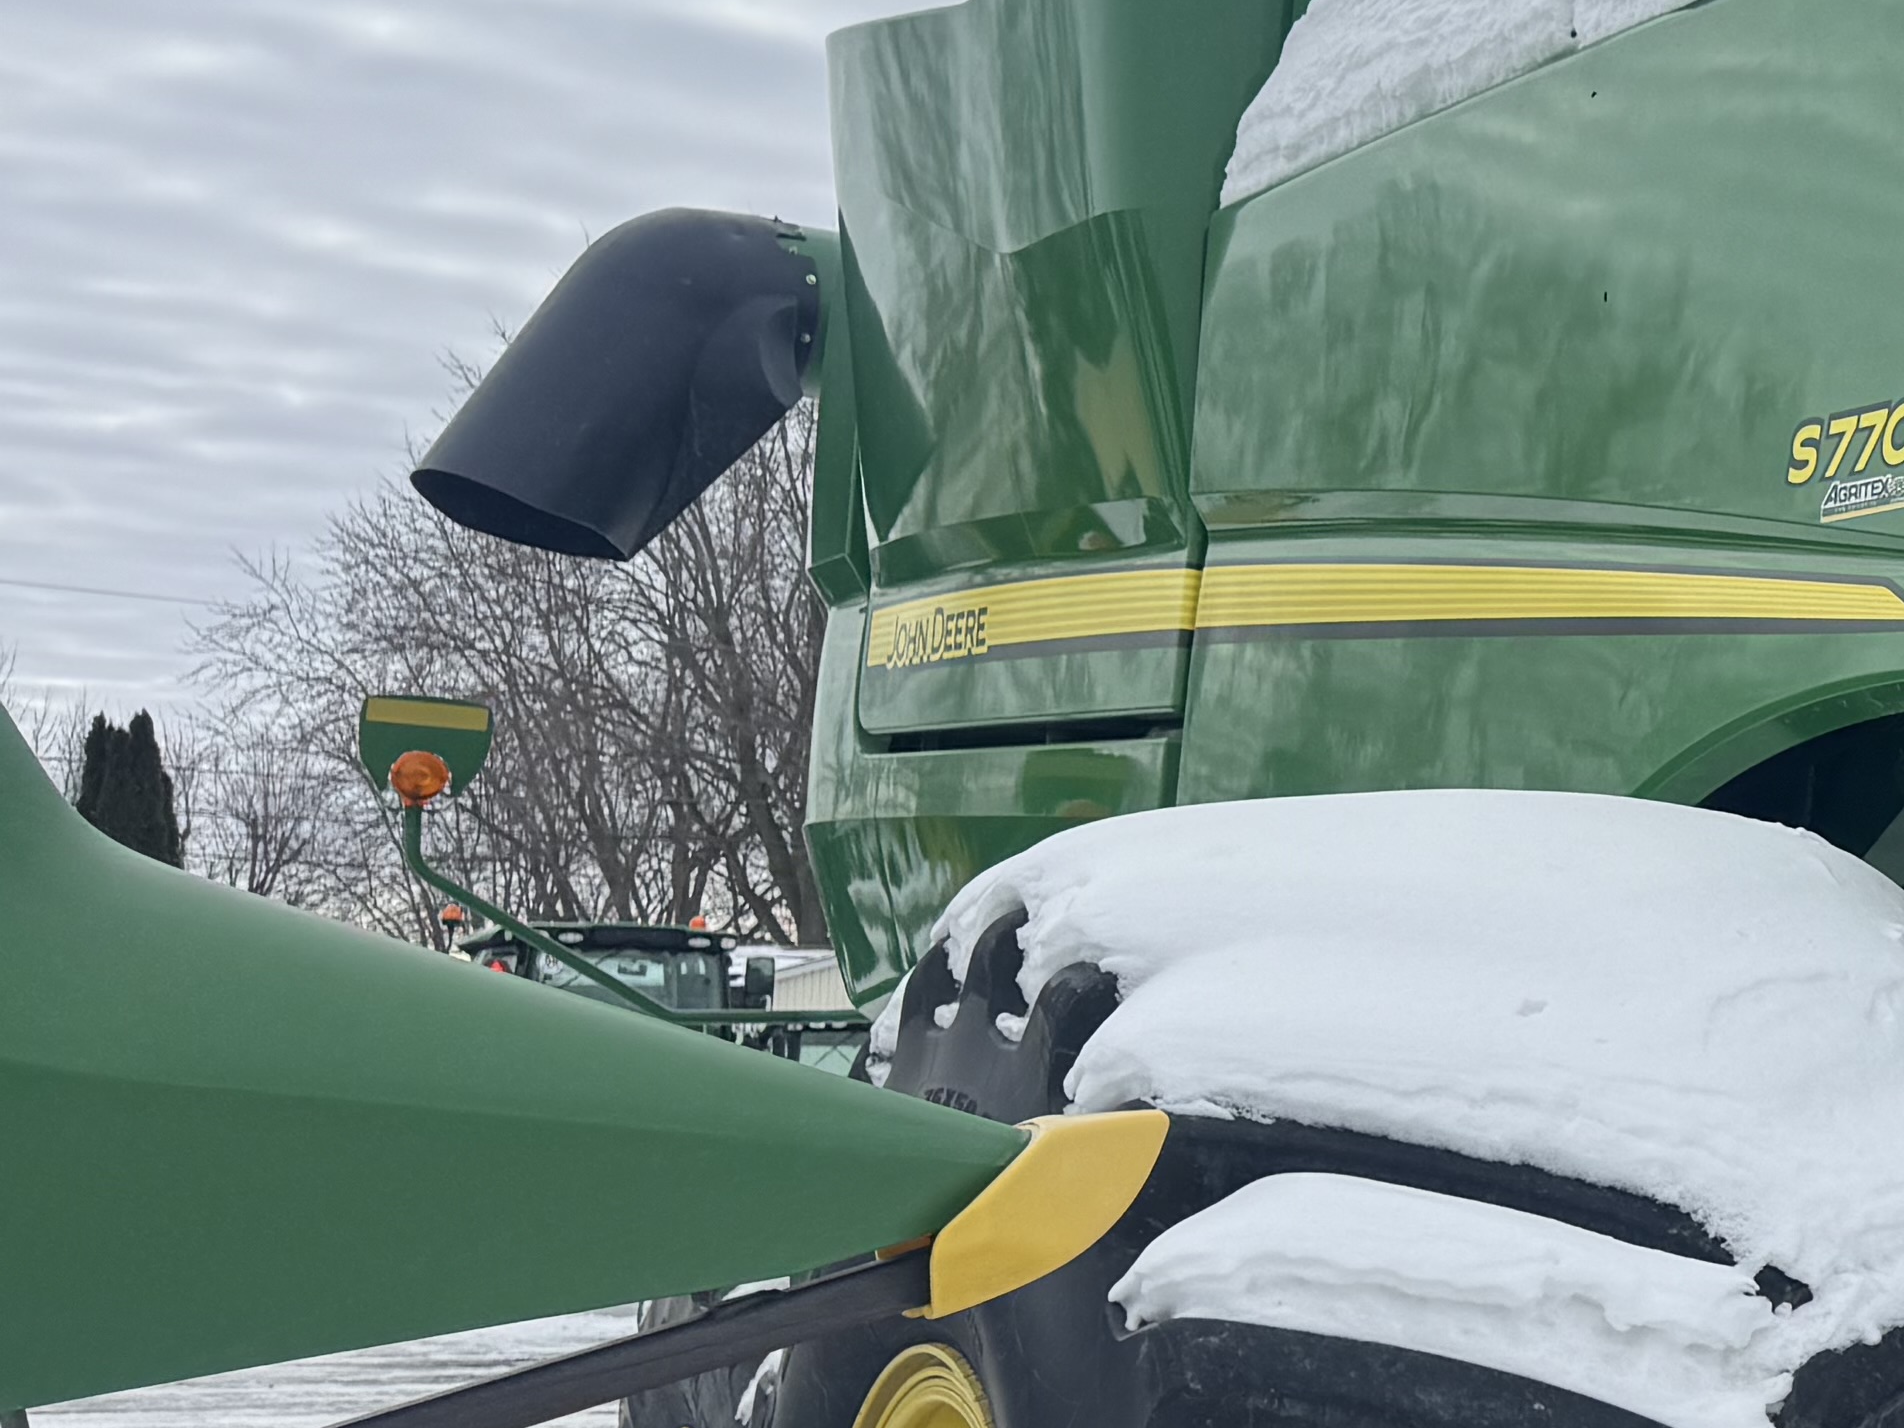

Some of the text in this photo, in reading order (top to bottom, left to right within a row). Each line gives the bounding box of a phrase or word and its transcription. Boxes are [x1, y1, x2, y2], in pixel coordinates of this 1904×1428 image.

[1823, 475, 1889, 506] AGRITEX
[886, 606, 988, 666] JOHN DEERE
